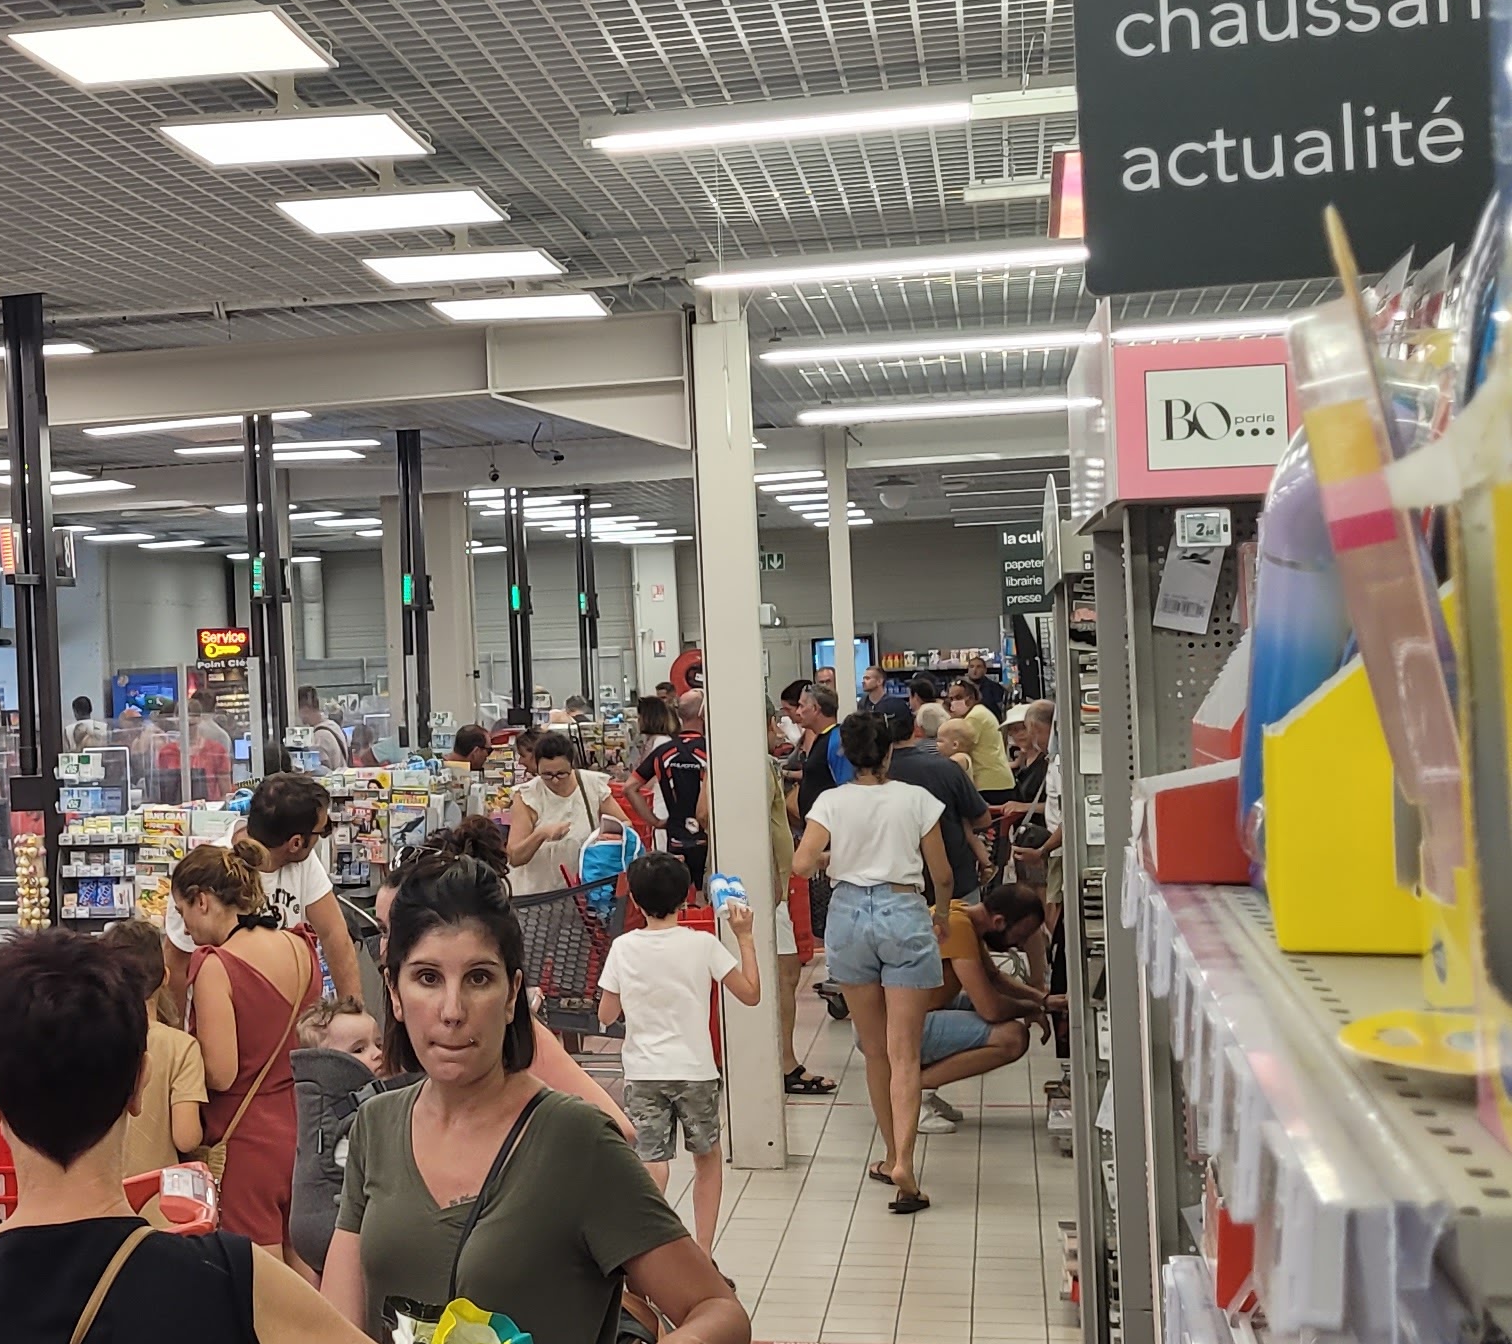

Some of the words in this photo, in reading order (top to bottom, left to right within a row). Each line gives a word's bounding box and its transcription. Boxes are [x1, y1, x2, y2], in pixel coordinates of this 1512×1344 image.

[1121, 96, 1465, 192] actualité
[1160, 398, 1231, 441] BO
[1234, 412, 1275, 425] paris
[1003, 532, 1016, 545] la
[13, 531, 21, 564] 7
[64, 537, 72, 568] 8
[1005, 575, 1042, 587] librairie
[1006, 594, 1042, 606] presse
[201, 630, 247, 644] Service
[197, 659, 225, 670] Point
